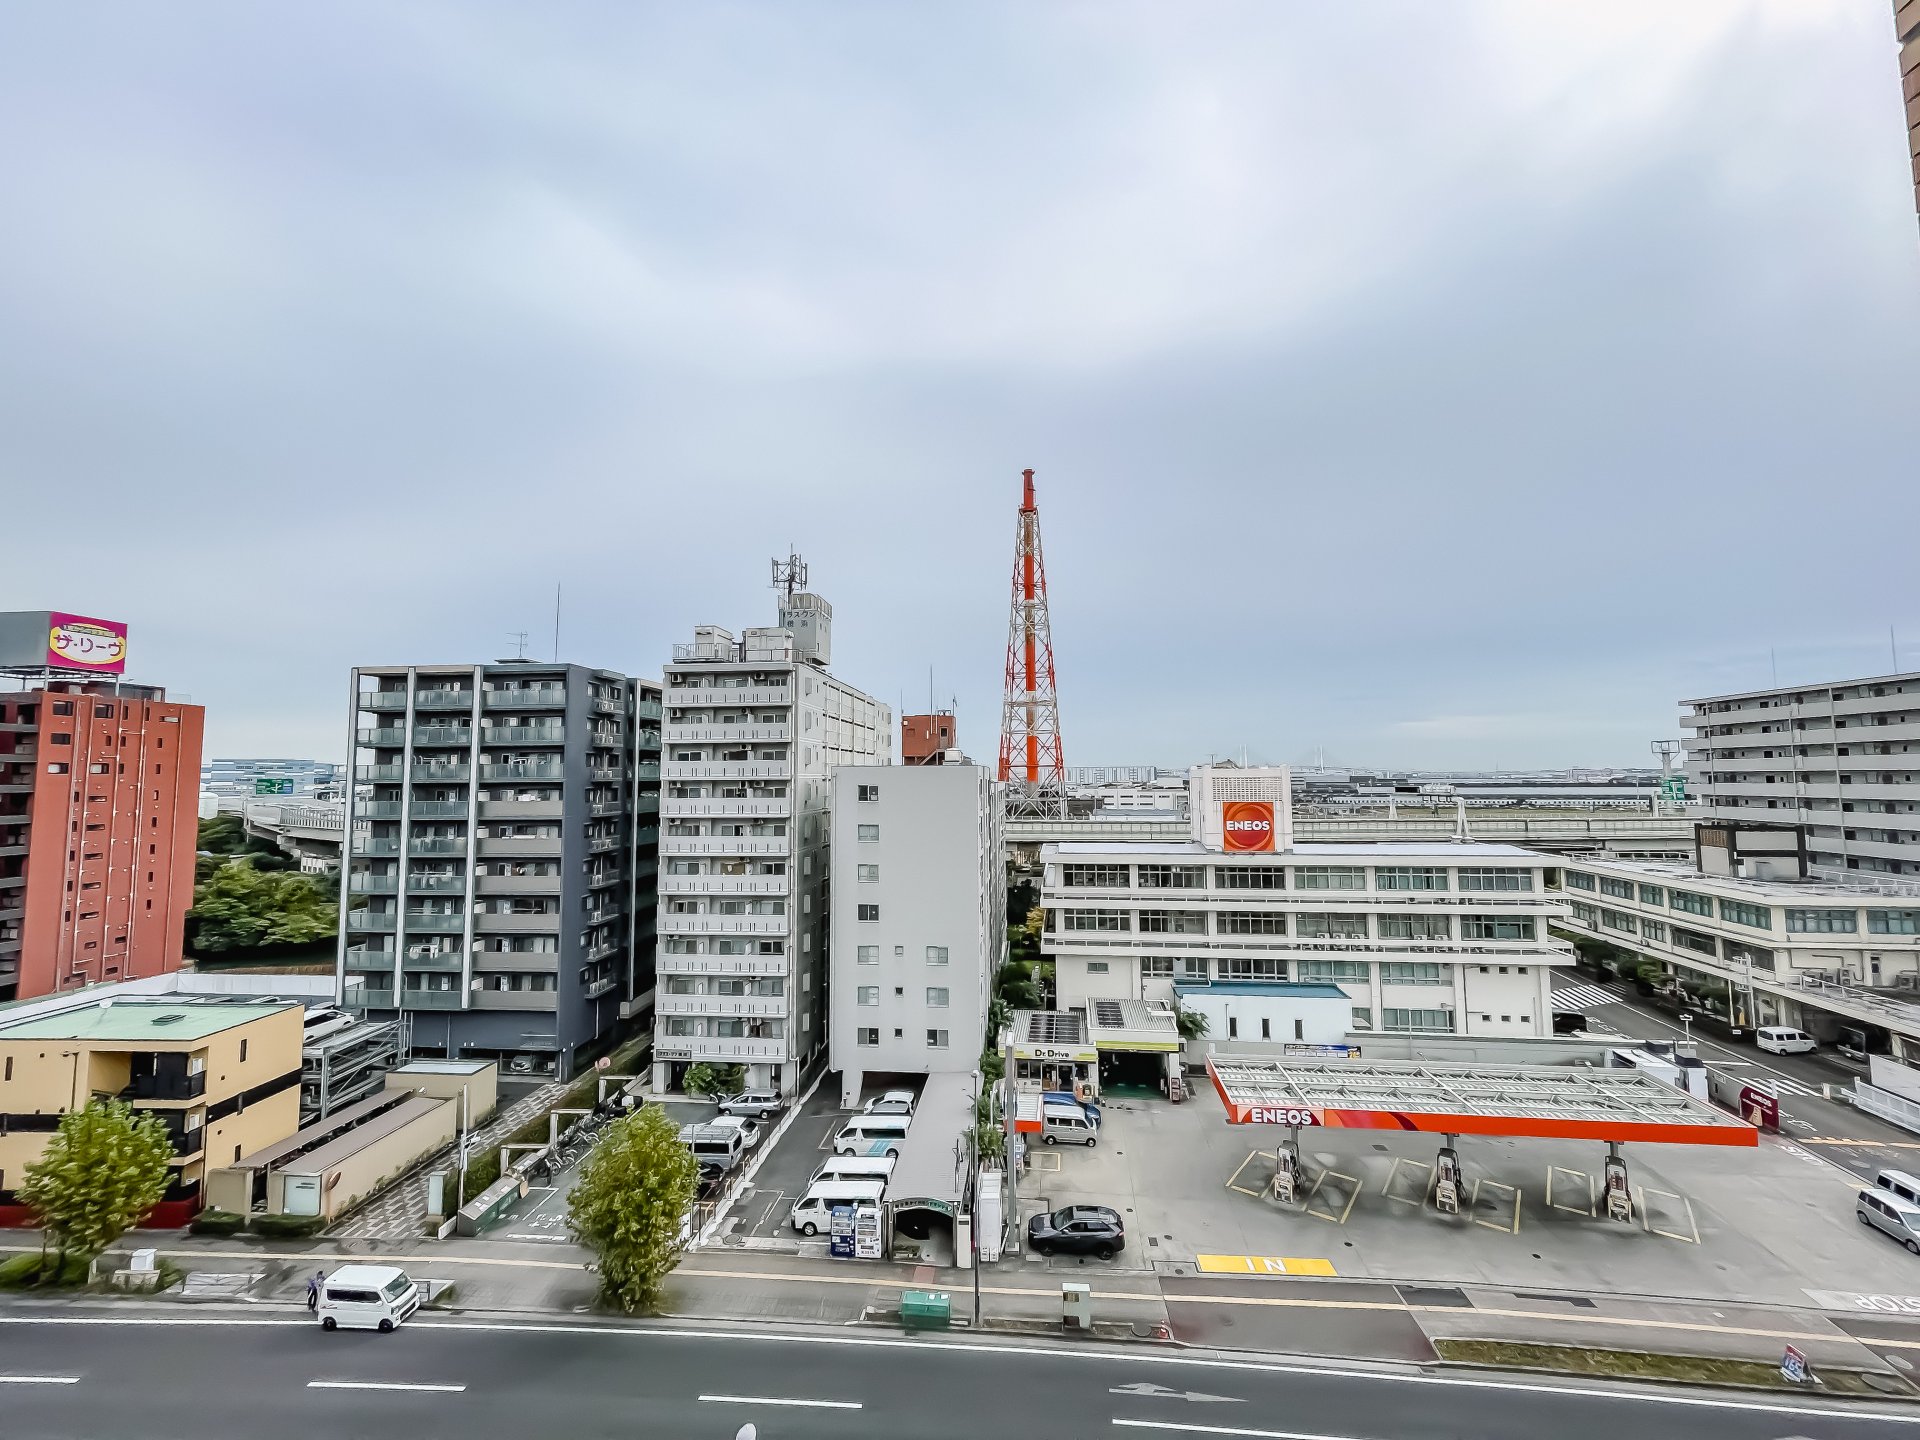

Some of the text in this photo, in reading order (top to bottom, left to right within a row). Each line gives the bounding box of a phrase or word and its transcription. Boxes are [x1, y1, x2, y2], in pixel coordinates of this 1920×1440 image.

[1226, 820, 1270, 831] ENEOS
[1251, 1108, 1312, 1125] ENEOS
[1245, 1256, 1287, 1272] IN
